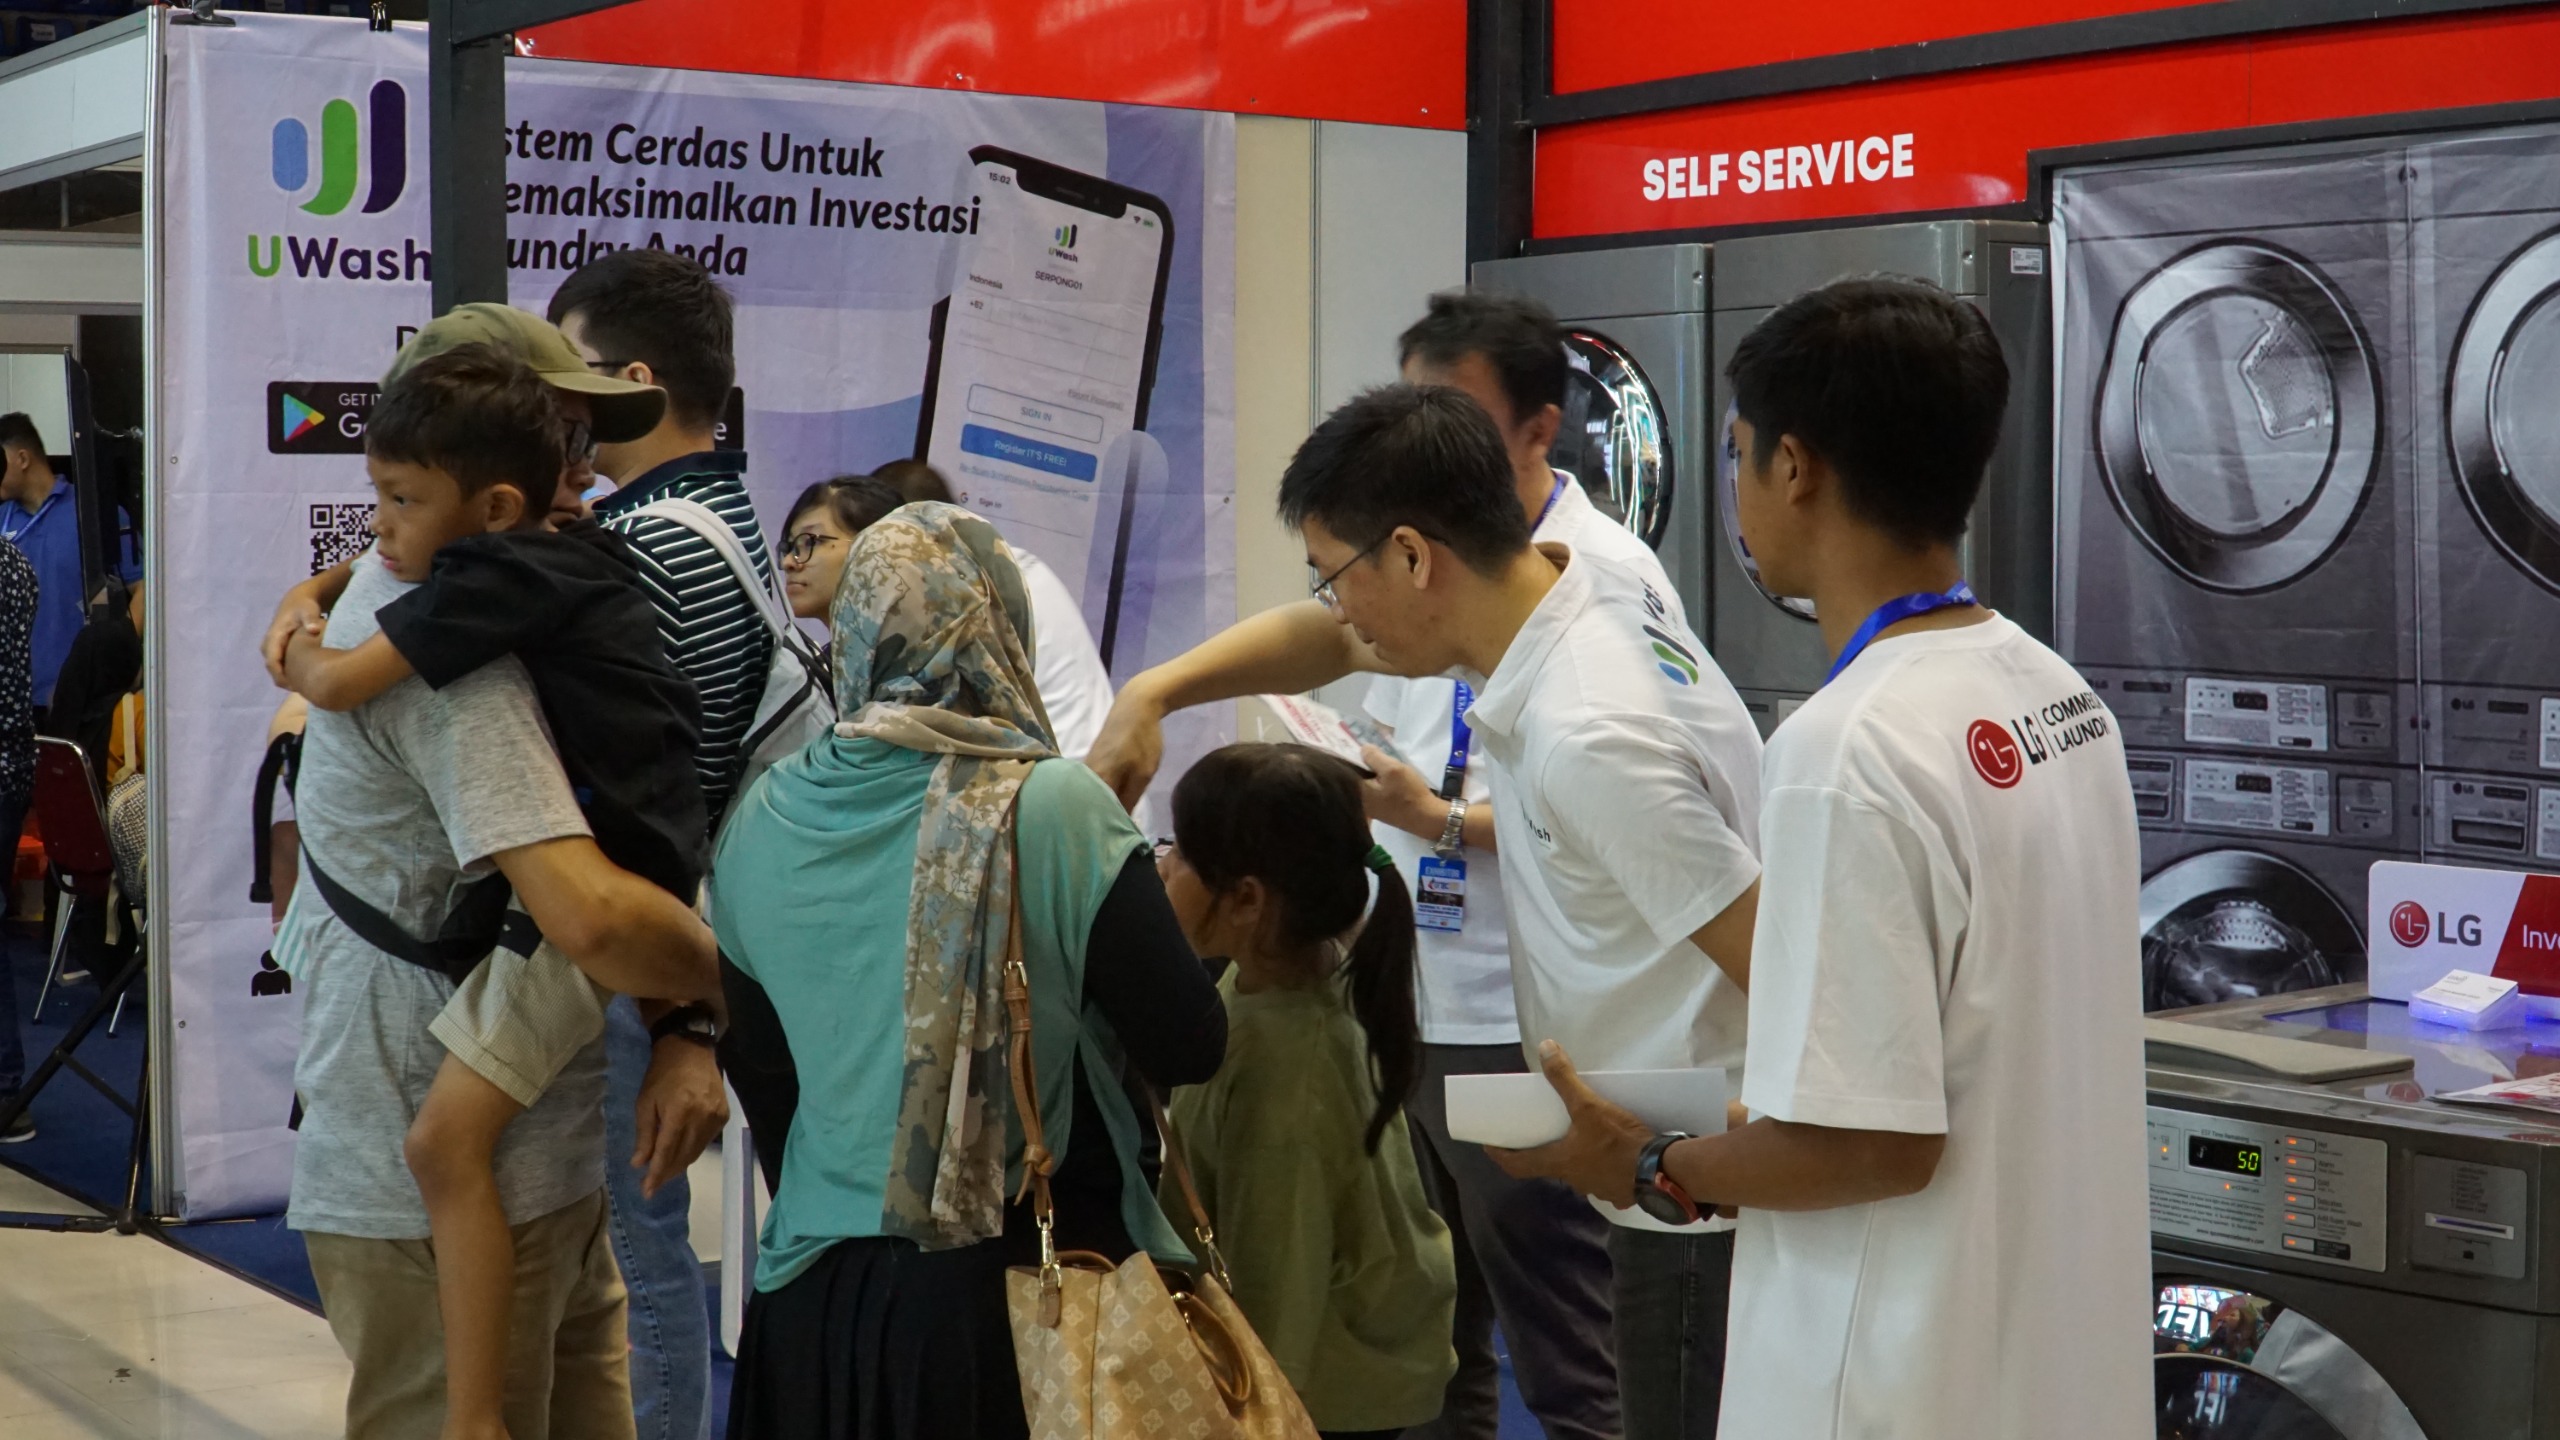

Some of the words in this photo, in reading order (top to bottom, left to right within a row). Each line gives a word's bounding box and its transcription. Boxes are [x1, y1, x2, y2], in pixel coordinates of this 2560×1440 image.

[606, 124, 748, 169] Cerdas
[760, 131, 885, 179] Untuk
[1643, 153, 1729, 201] SELF
[1738, 133, 1914, 194] SERVICE
[988, 171, 1012, 185] 15:02
[505, 175, 797, 226] emaksimalkan
[809, 187, 981, 235] Investasi
[1035, 270, 1083, 291] SERPONG01
[338, 393, 367, 406] GET
[1020, 406, 1041, 420] SIGN
[994, 440, 1026, 455] Register
[2011, 715, 2048, 766] LG
[2438, 911, 2482, 947] LG
[2238, 1151, 2259, 1171] 50
